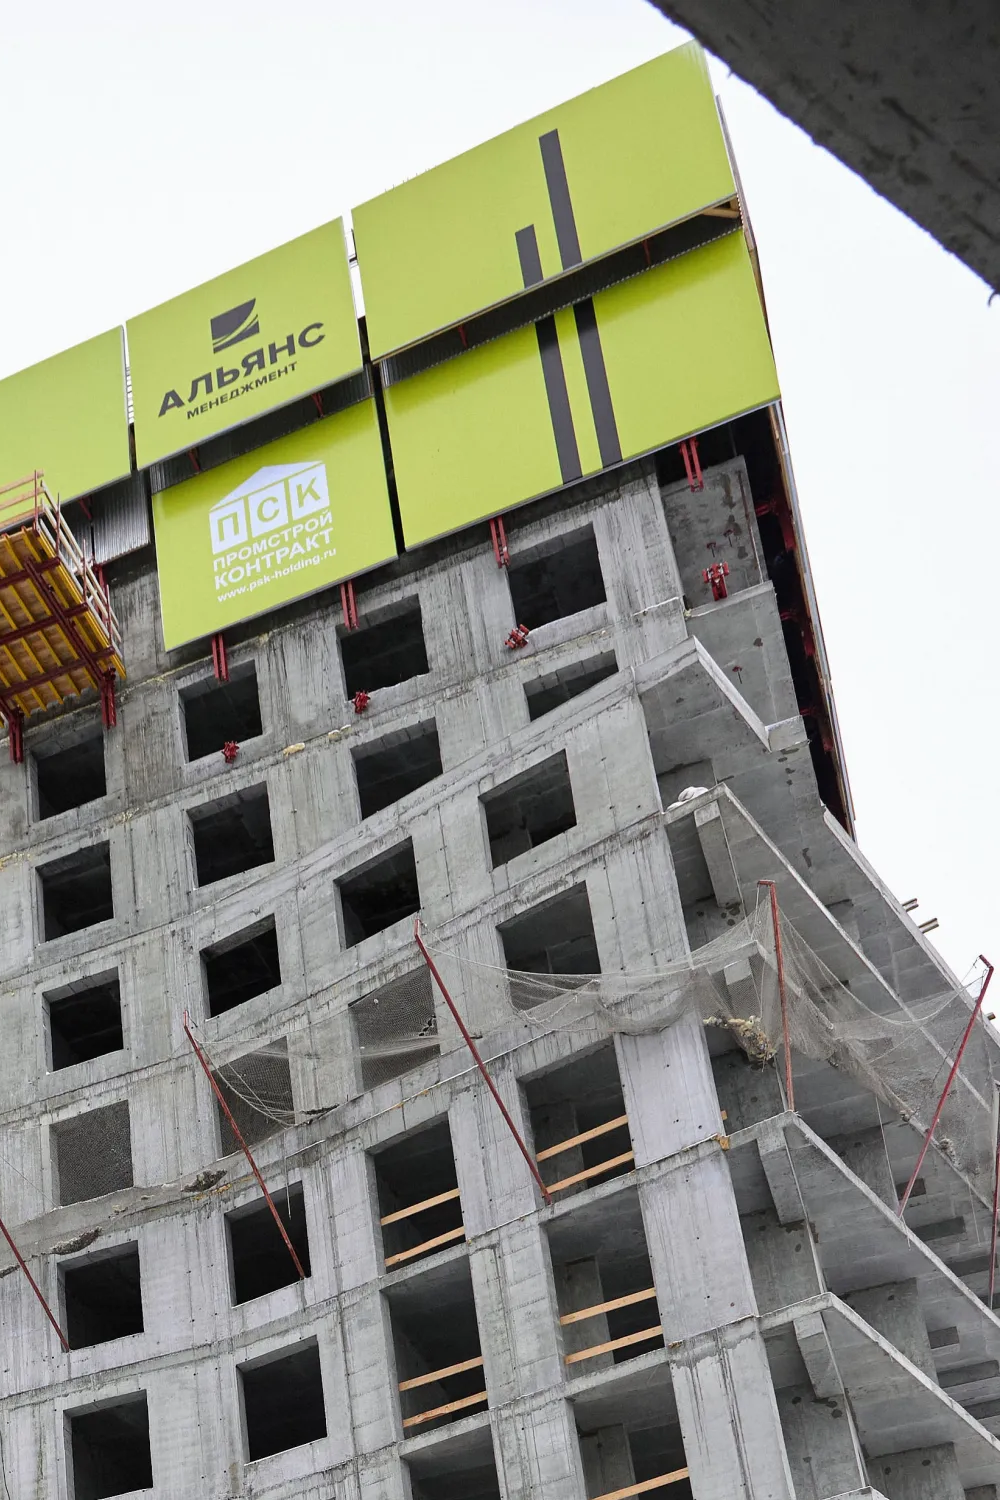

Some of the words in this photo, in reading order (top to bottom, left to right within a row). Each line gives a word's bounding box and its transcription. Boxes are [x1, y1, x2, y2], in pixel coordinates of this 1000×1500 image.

[158, 322, 326, 417] АЛЬЯНС
[186, 362, 298, 420] МЕНЕДЖМЕНТ
[212, 475, 325, 549] ПСК
[212, 510, 333, 572] ПРОМСТРОЙ
[214, 528, 334, 590] КОНТРАКТ
[217, 547, 337, 603] www.psk-holding.ru
